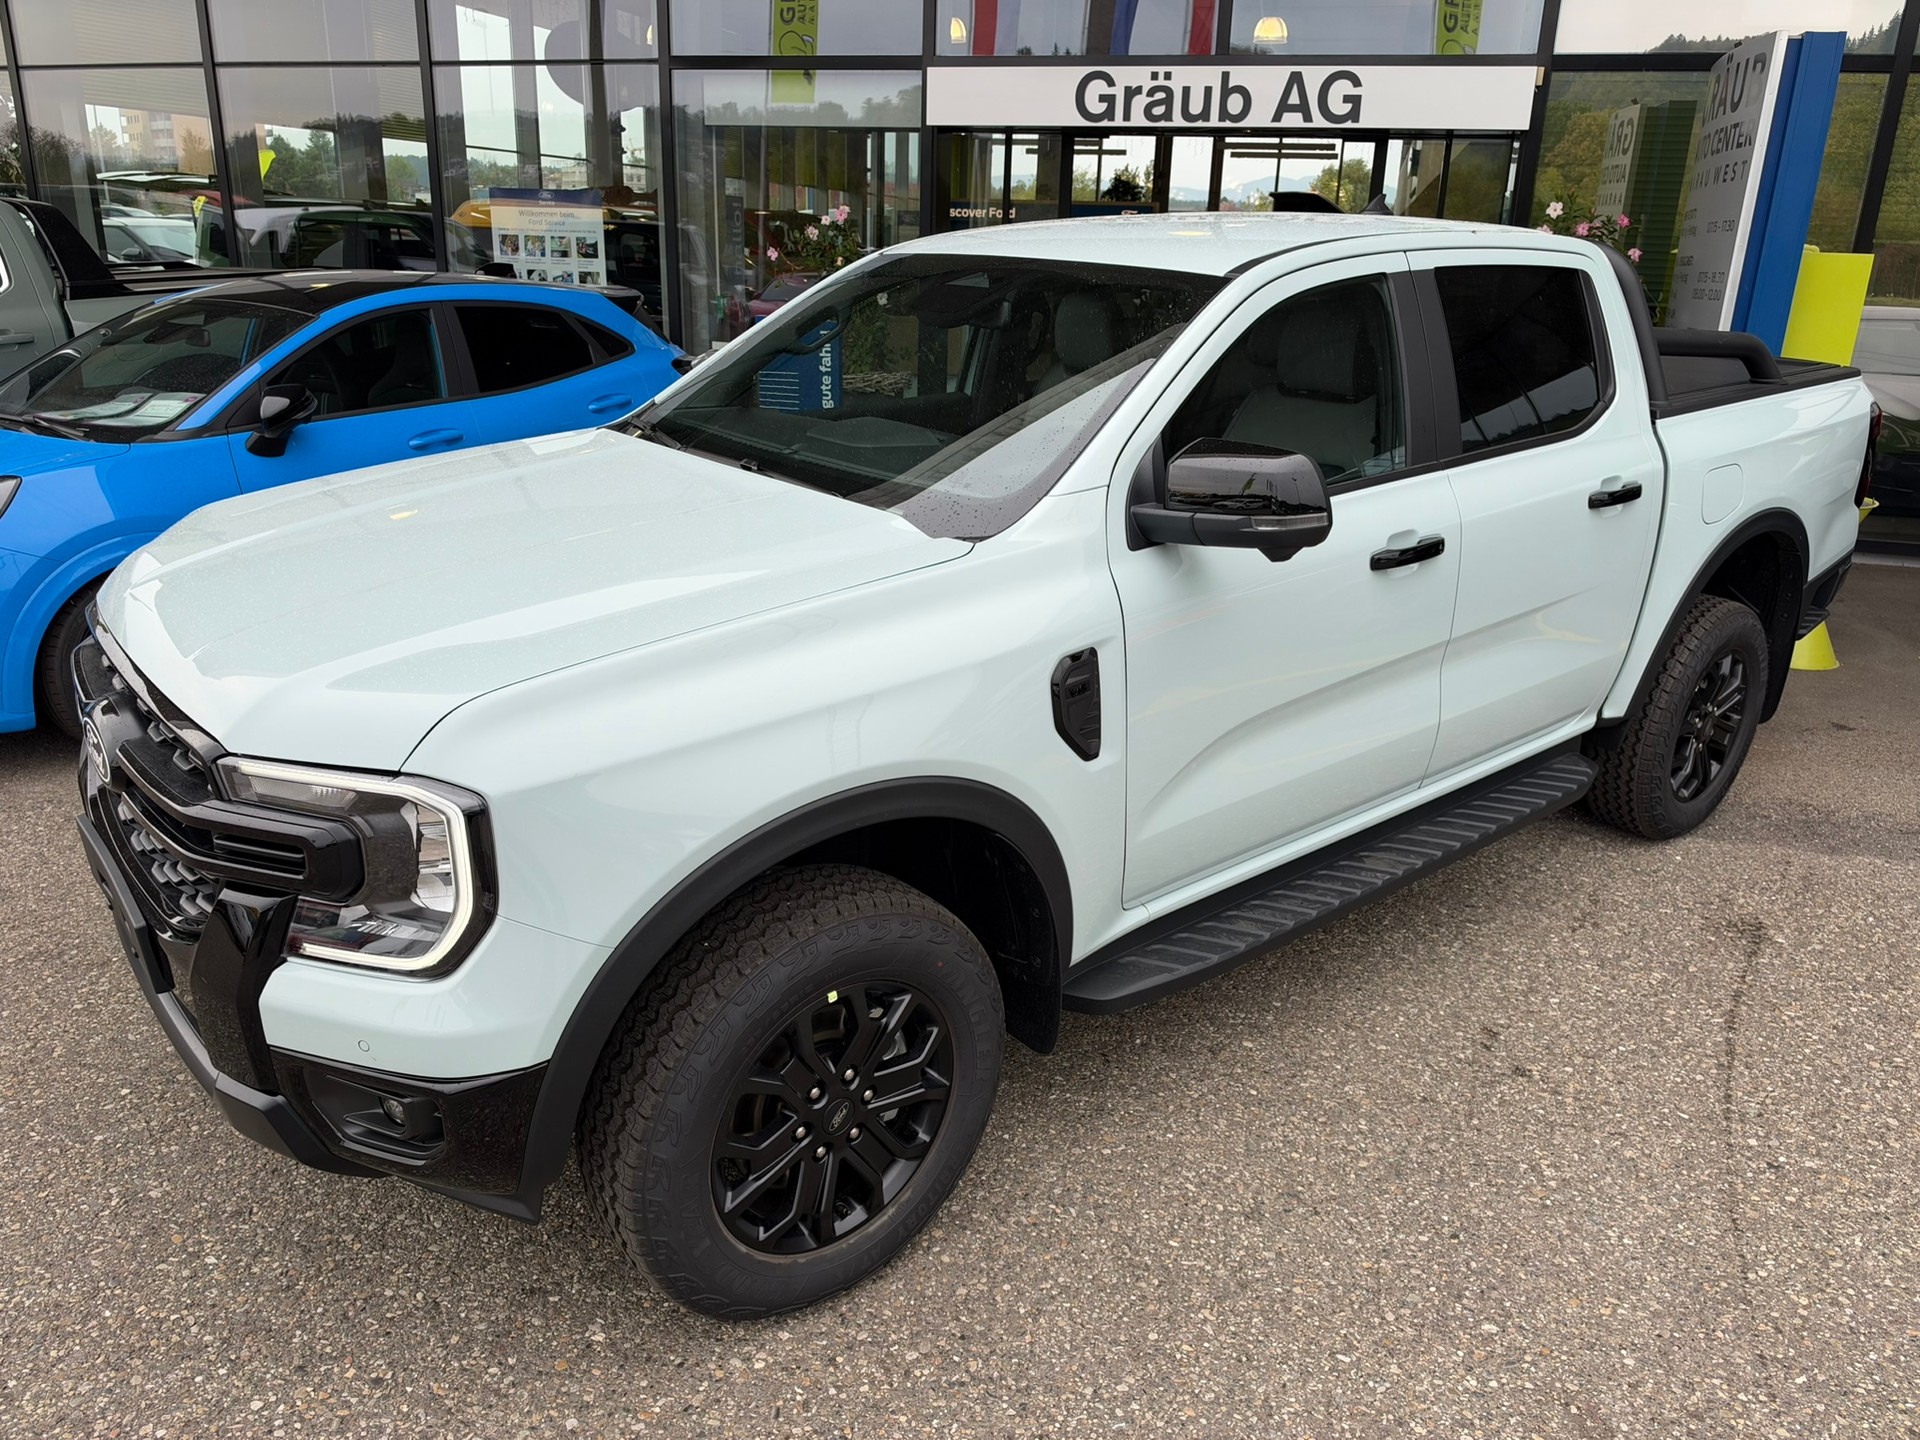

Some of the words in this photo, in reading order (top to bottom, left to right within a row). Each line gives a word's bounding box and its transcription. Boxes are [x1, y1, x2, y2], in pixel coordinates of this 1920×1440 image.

[1075, 70, 1252, 123] Gräub
[1271, 70, 1363, 124] AG
[1713, 160, 1748, 185] WEST
[518, 209, 558, 217] Willkommen
[988, 207, 1016, 219] Fod
[820, 375, 835, 409] gute
